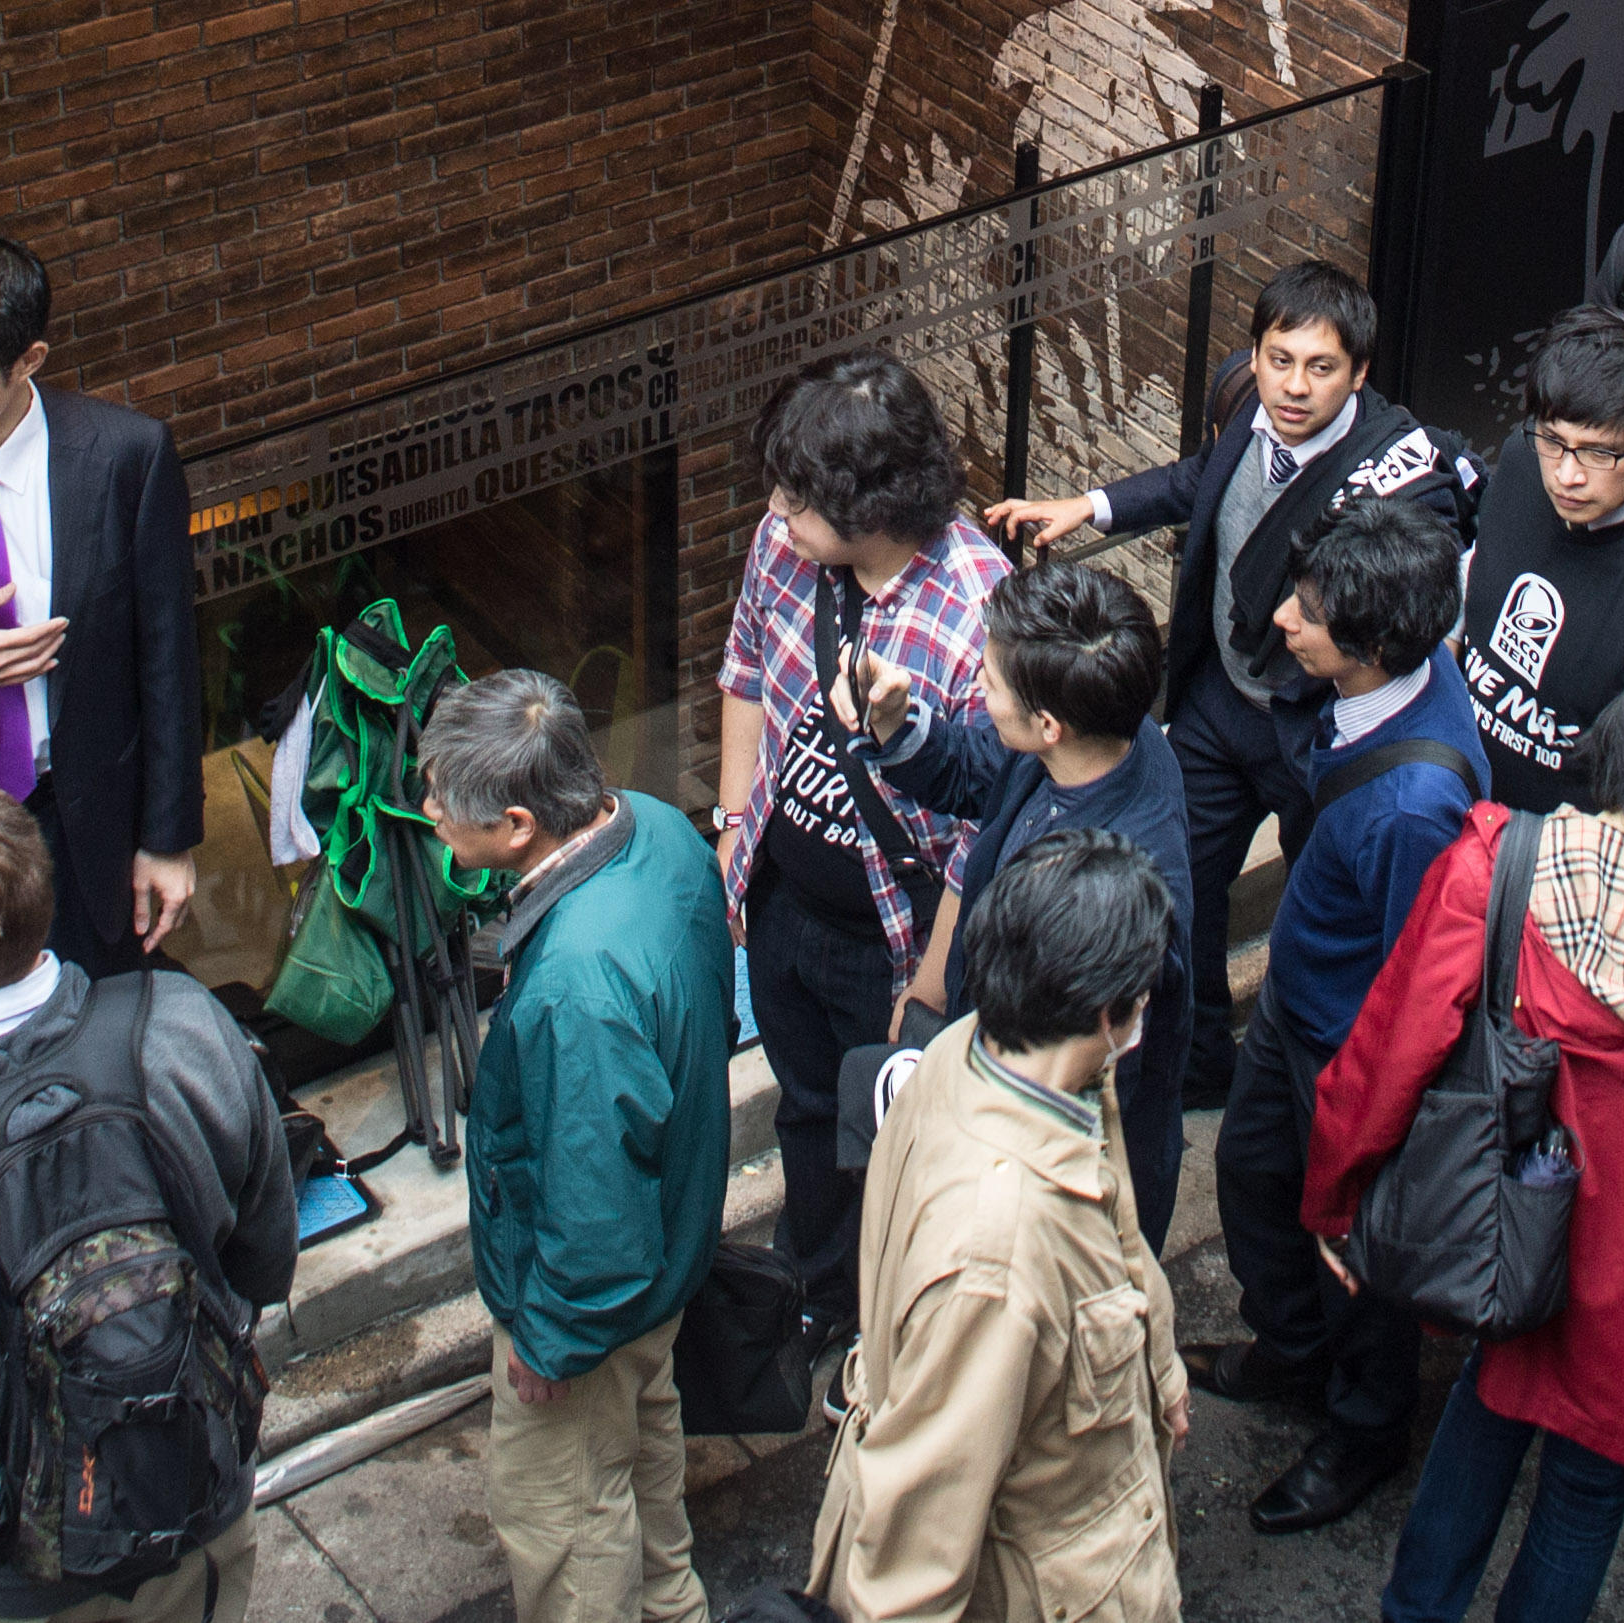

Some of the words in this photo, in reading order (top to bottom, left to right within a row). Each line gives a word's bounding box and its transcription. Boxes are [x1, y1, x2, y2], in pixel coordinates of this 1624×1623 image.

[327, 374, 496, 463] NACHOS
[647, 243, 900, 364] QUESADILLA
[284, 417, 503, 520] QUESADILLA
[503, 362, 647, 446] TACOS
[215, 502, 386, 591] NACHOS
[390, 482, 469, 534] BURRITO
[477, 406, 700, 506] QUESADILLA
[1497, 635, 1536, 681] BELL
[1500, 619, 1541, 665] TACO
[1491, 716, 1535, 758] FIRST
[1534, 745, 1562, 771] 100
